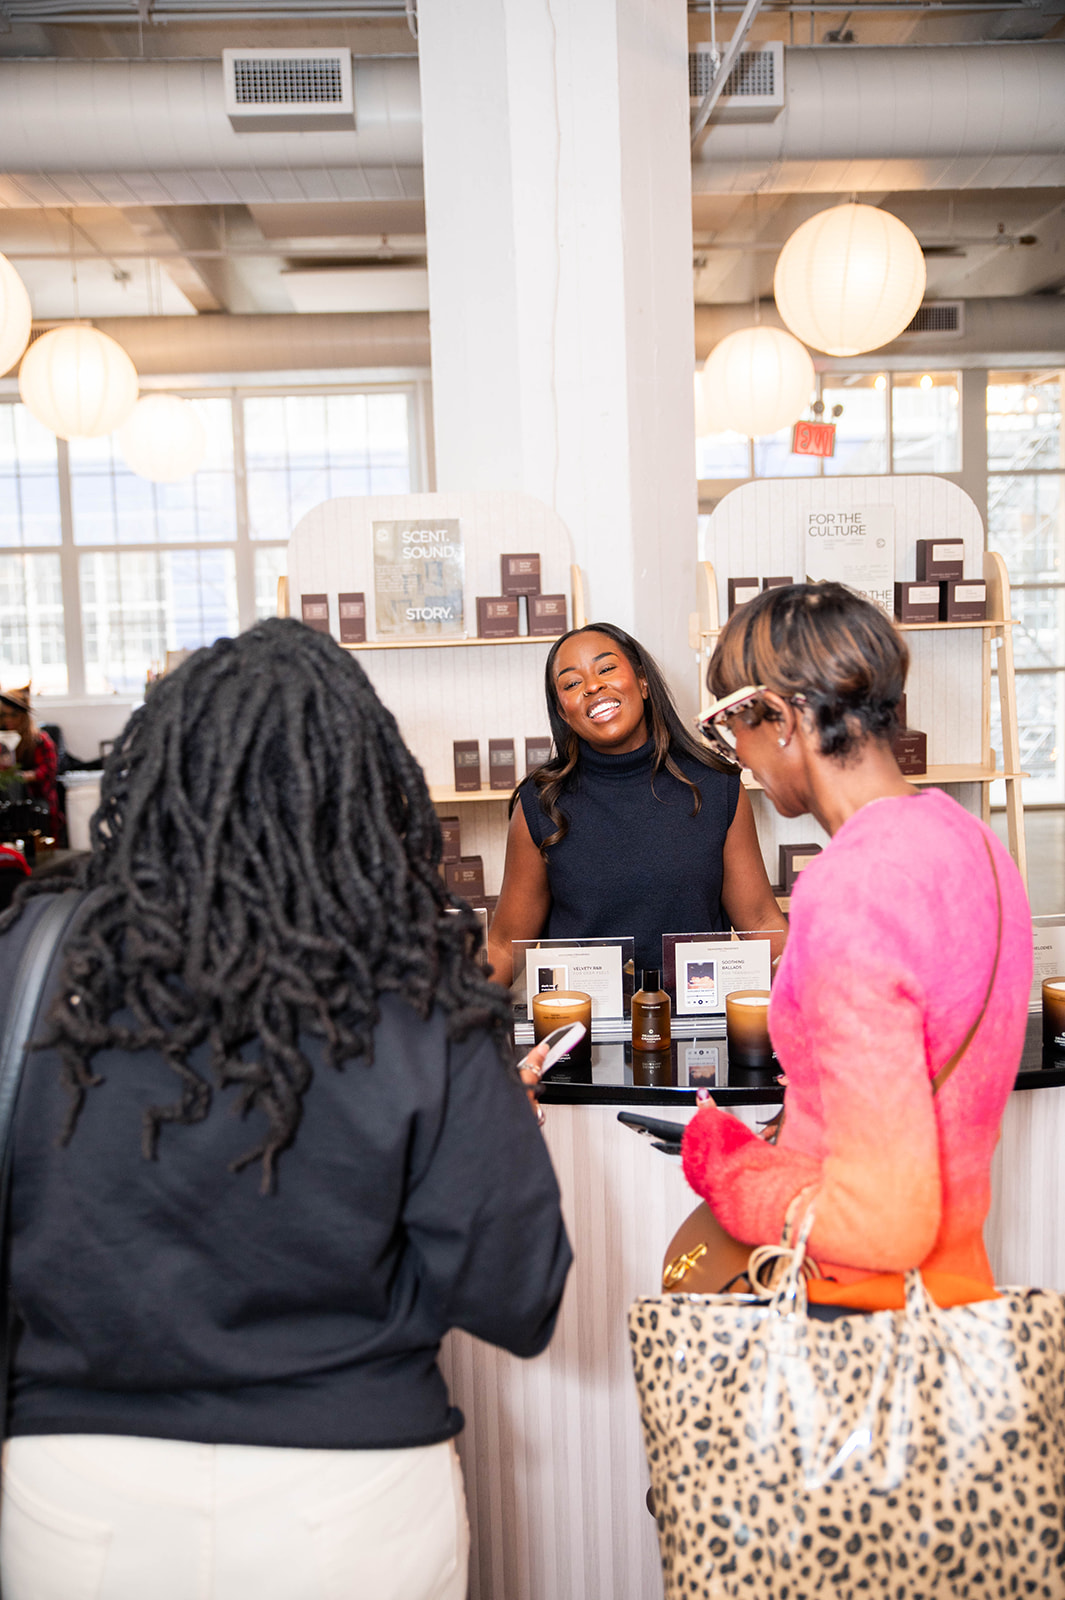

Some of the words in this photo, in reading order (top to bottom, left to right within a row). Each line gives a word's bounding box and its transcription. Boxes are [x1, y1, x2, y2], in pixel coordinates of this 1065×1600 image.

[808, 513, 836, 525] FOR
[837, 512, 862, 524] THE
[402, 530, 450, 544] SCENT.
[808, 524, 867, 537] CULTURE
[869, 589, 893, 601] THE
[406, 606, 454, 620] STORY.
